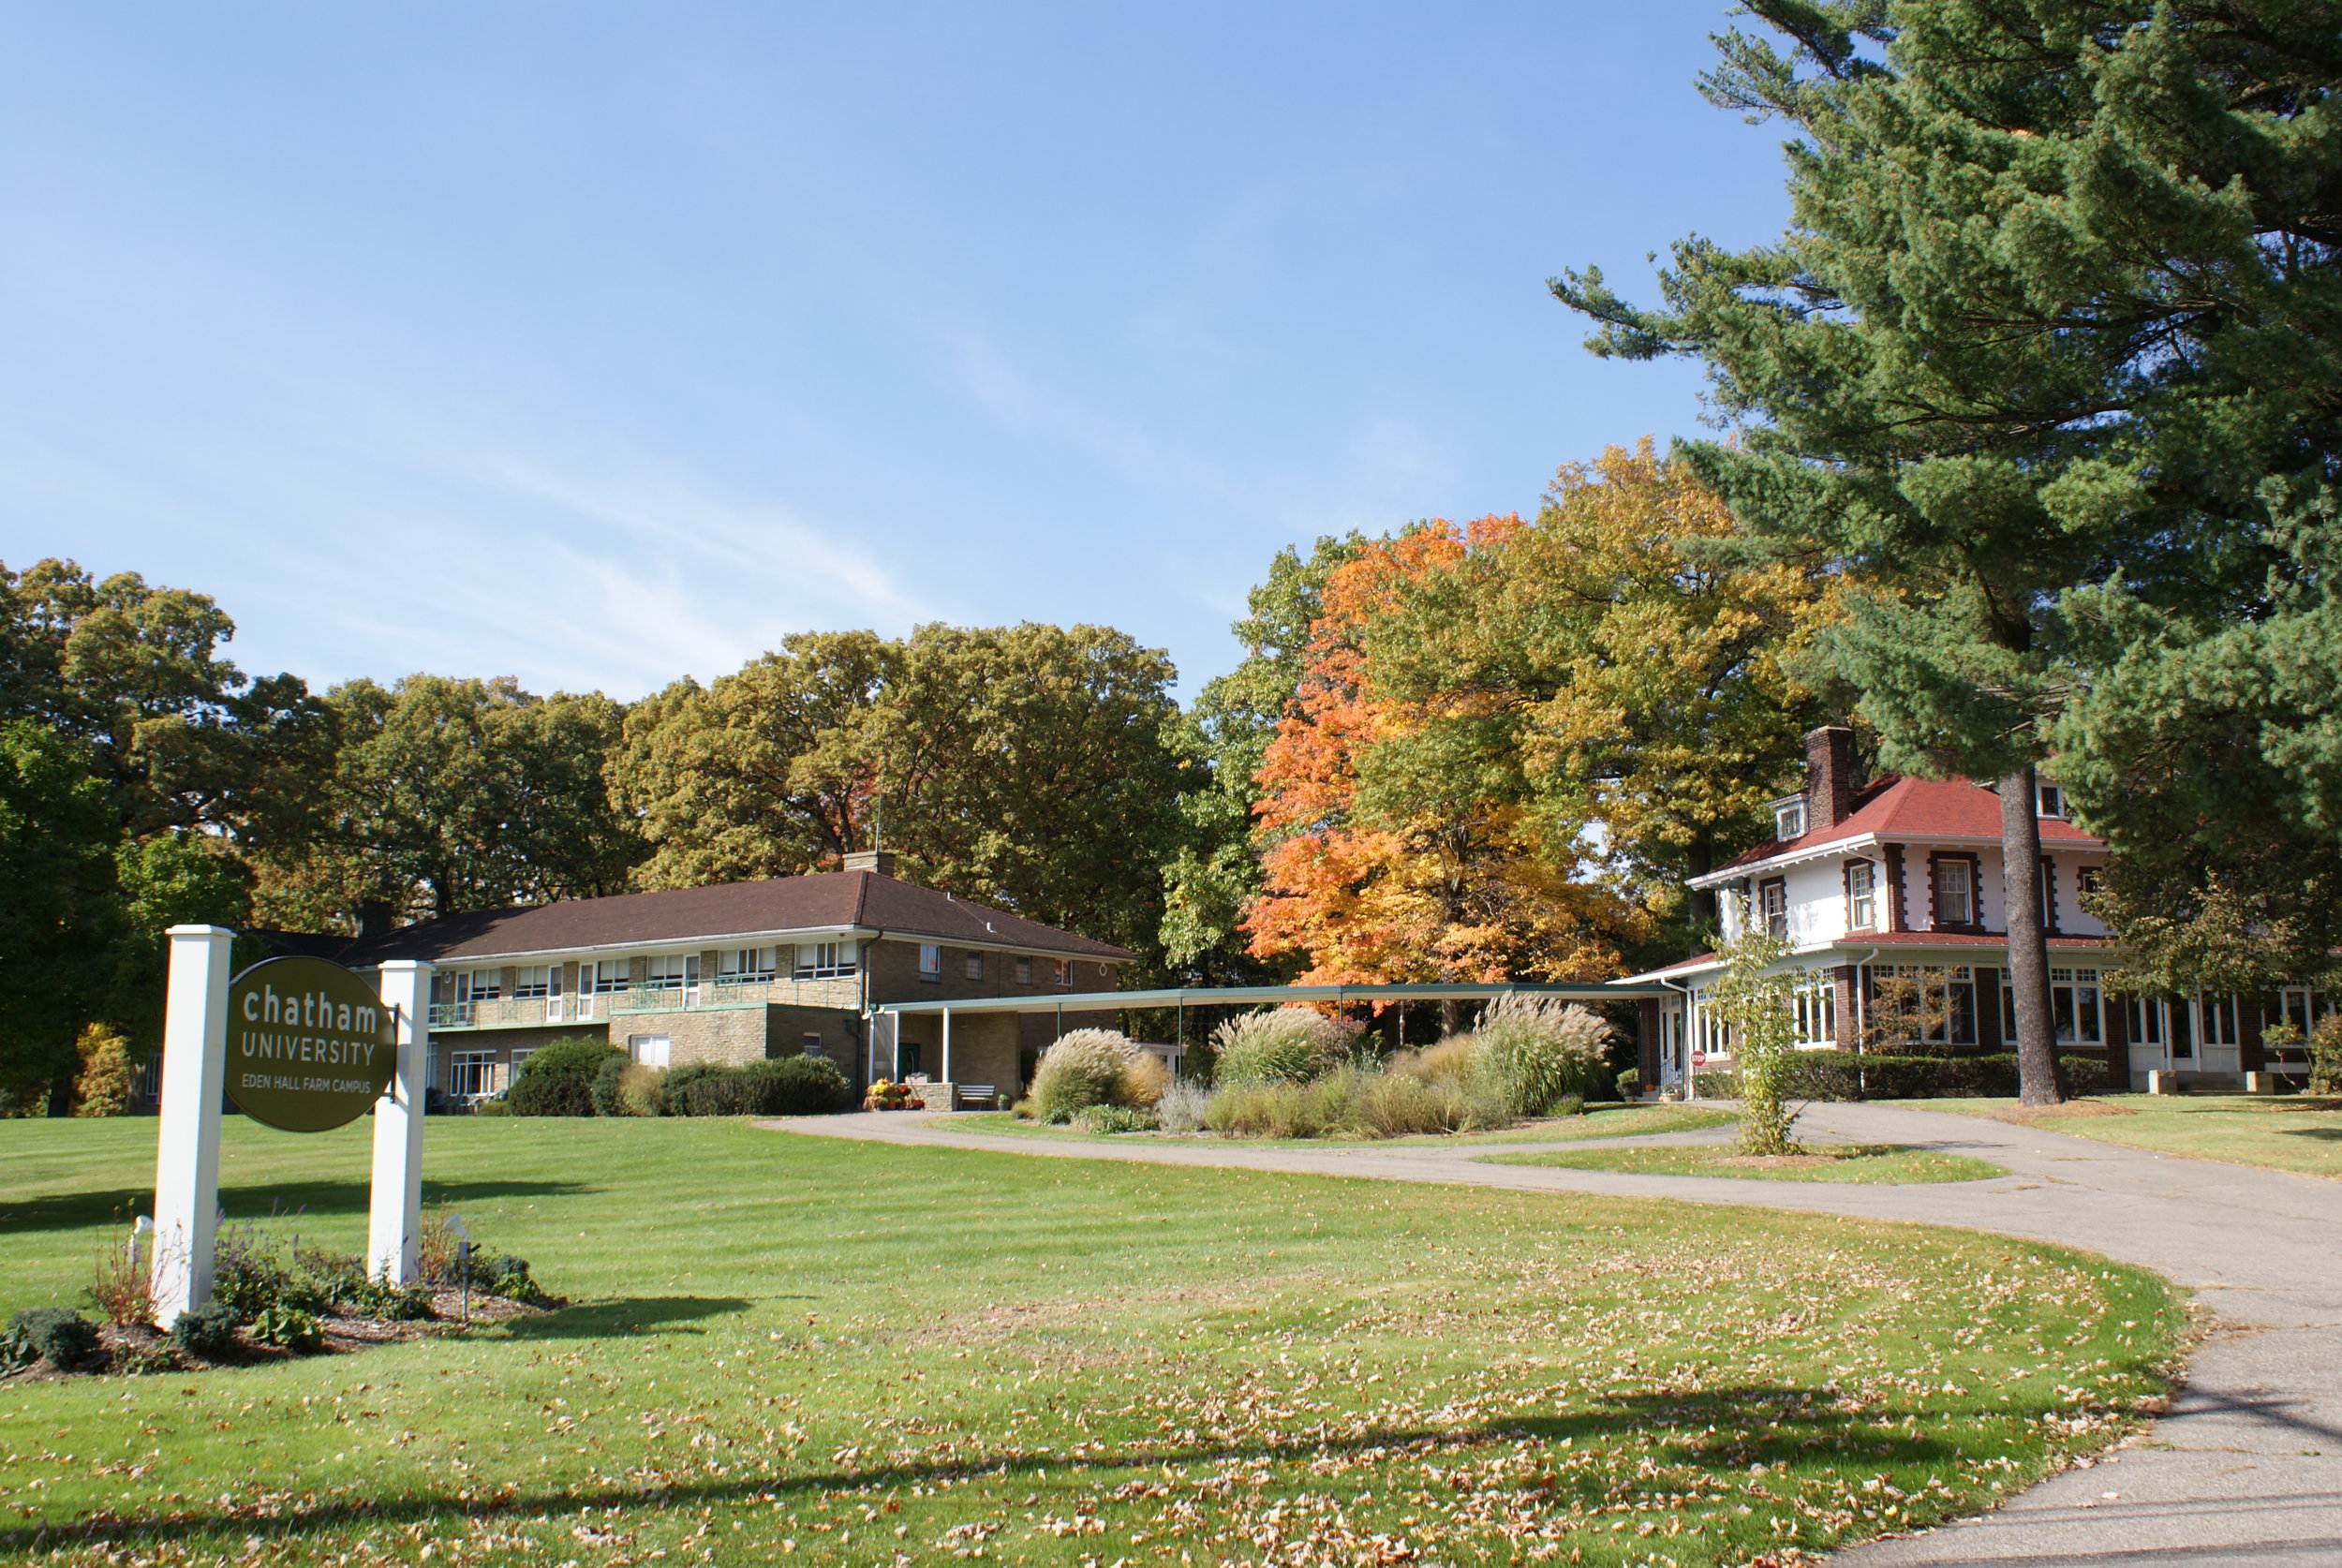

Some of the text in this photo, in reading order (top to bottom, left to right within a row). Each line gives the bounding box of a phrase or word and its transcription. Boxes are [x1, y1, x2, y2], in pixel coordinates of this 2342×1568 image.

[243, 984, 377, 1034] chatham
[242, 1031, 375, 1066] UNIVERSITY
[1691, 1055, 1705, 1063] STOP
[242, 1073, 371, 1094] EDEN HALL FARM CAMPUS
